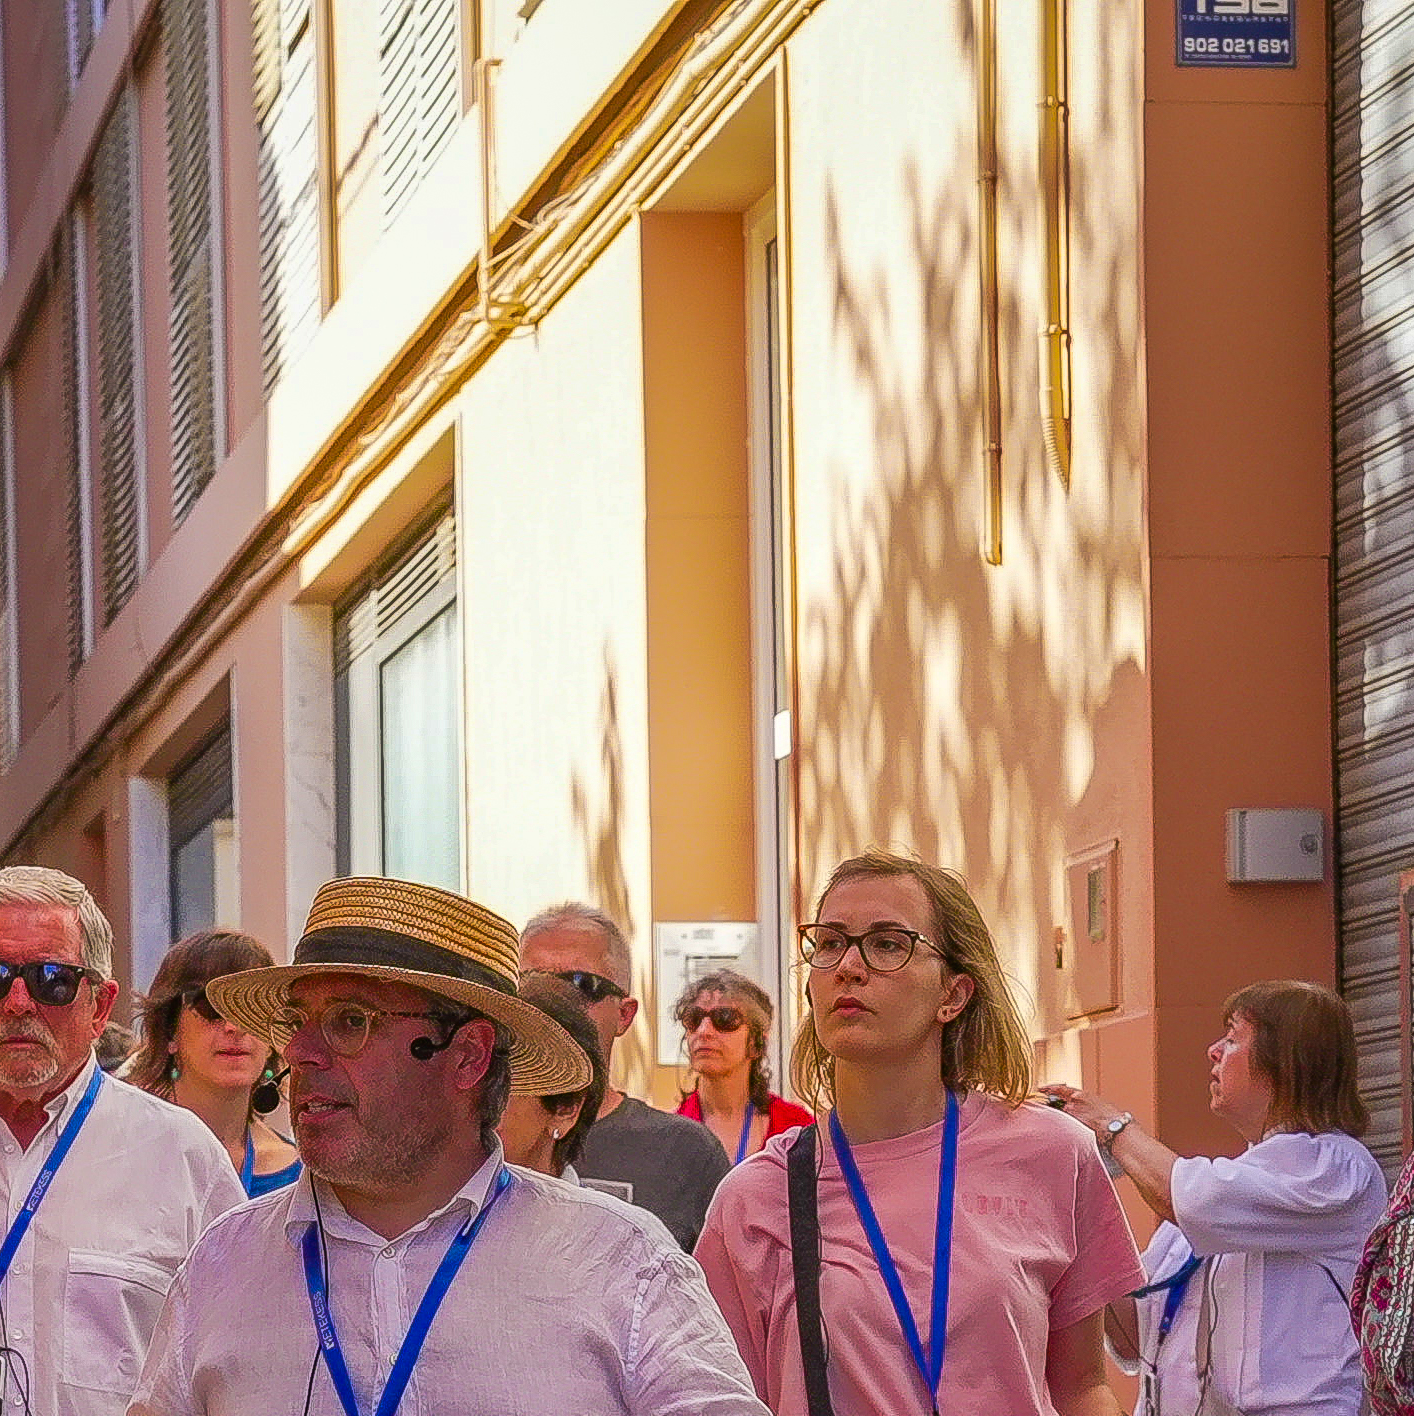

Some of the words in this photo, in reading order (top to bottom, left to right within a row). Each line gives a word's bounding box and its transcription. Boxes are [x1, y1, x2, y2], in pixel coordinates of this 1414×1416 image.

[1184, 37, 1219, 53] 902
[1222, 38, 1255, 53] 021
[1258, 38, 1289, 54] 691
